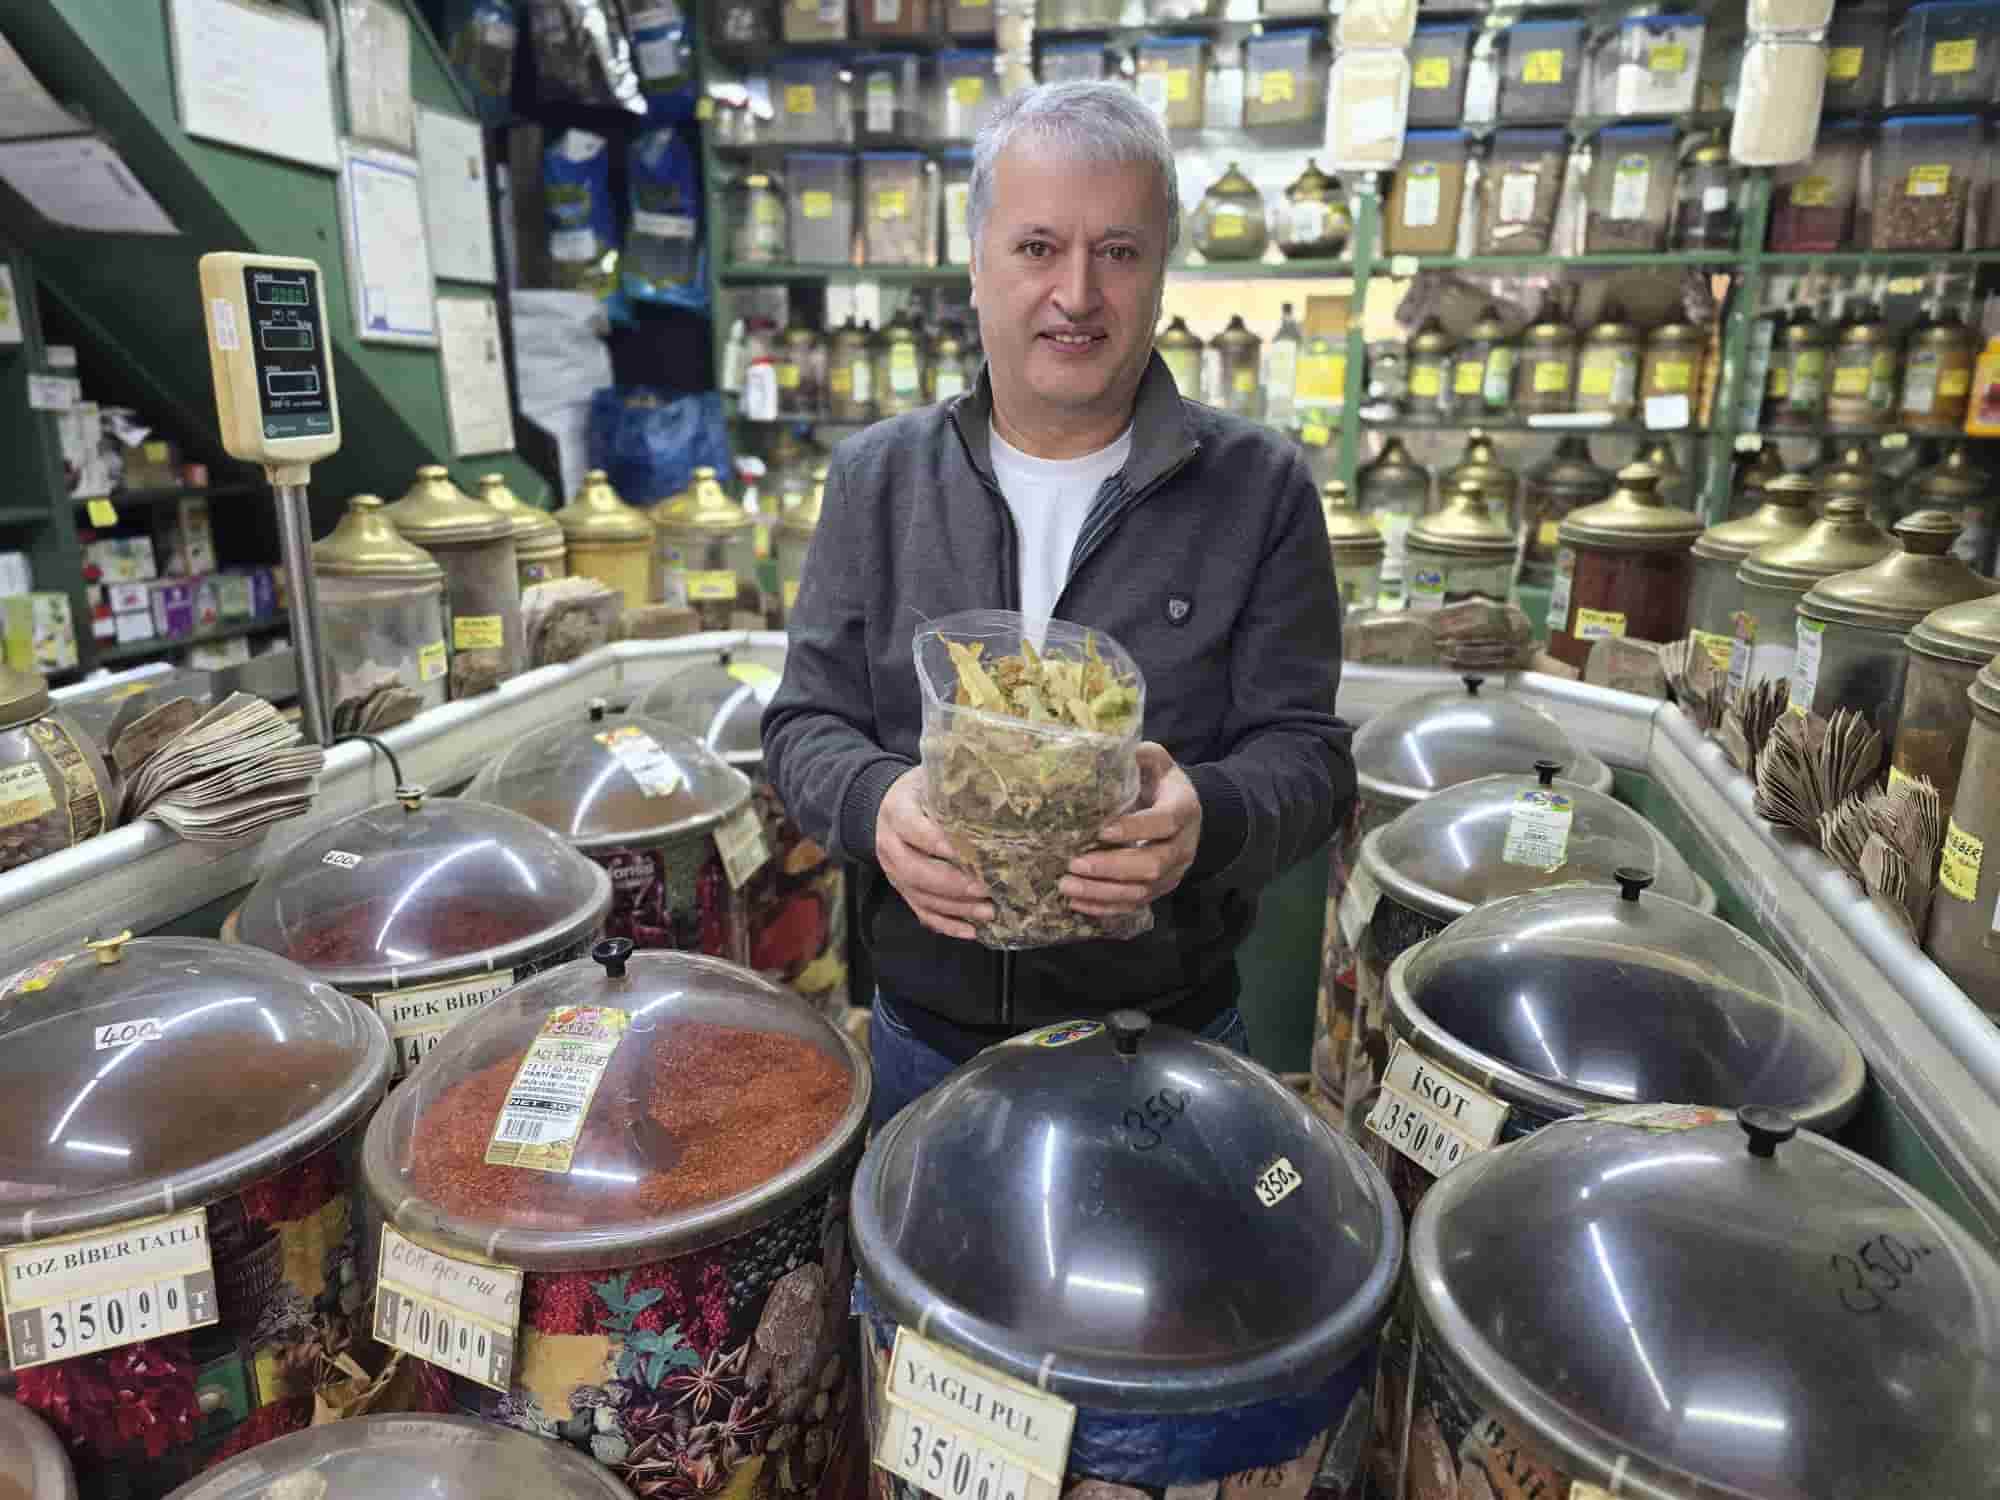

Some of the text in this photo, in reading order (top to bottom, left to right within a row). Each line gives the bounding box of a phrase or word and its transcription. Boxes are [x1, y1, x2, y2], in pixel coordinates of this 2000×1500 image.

[392, 1000, 440, 1022] İPEK
[1412, 1065, 1470, 1119] İSOT
[15, 1224, 202, 1280] TOZ BİBER TATLI
[991, 1400, 1039, 1442] PUL
